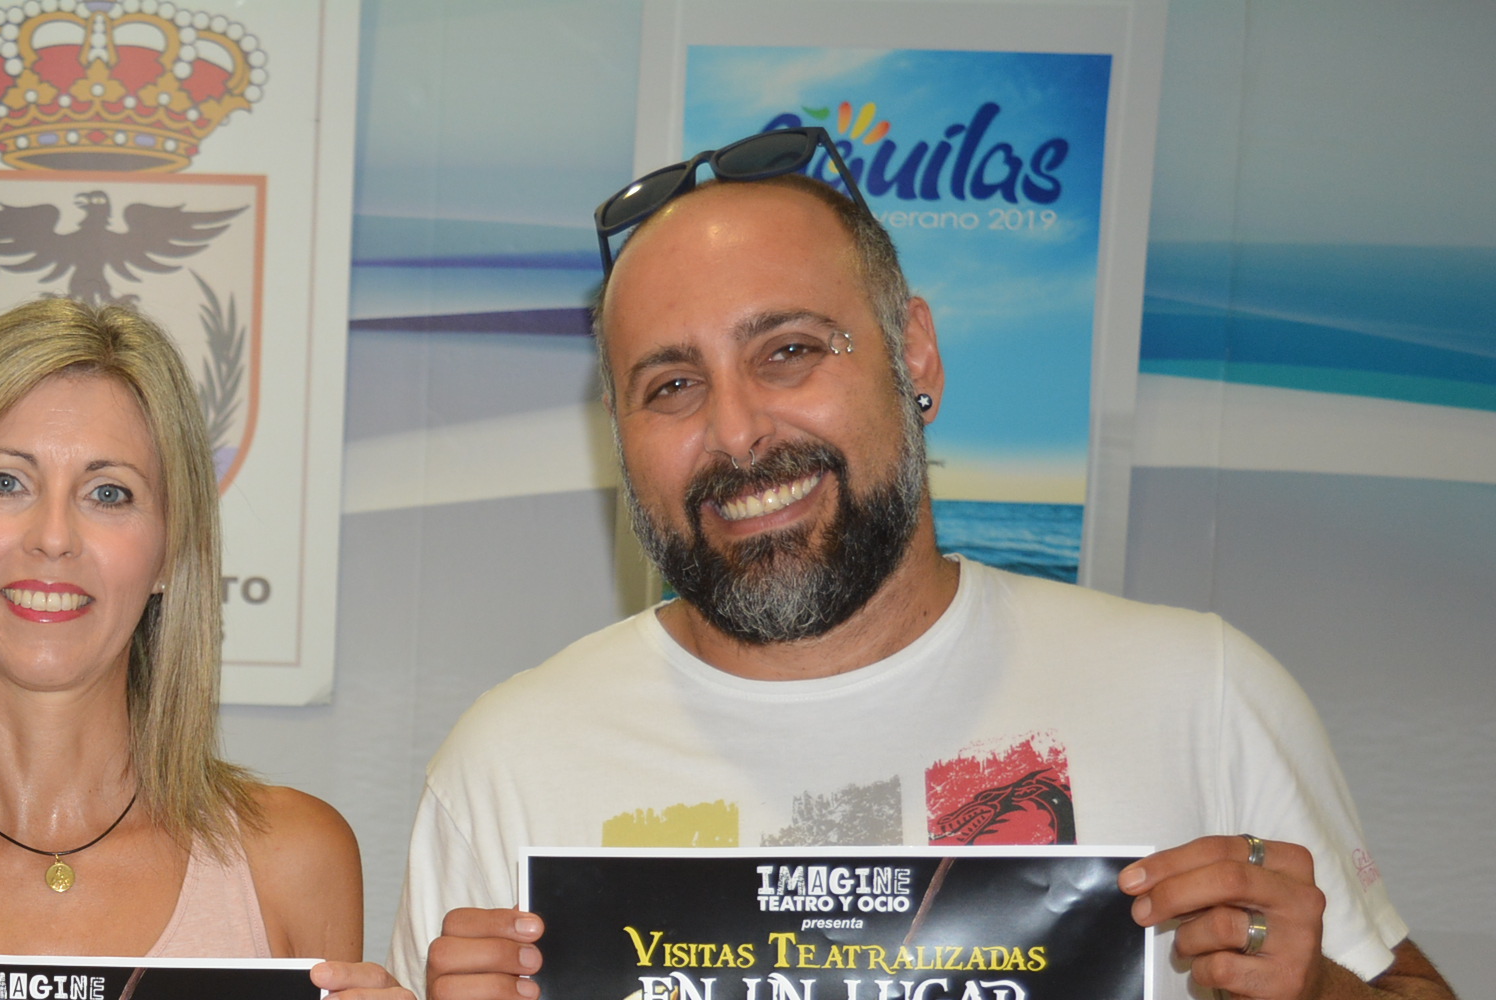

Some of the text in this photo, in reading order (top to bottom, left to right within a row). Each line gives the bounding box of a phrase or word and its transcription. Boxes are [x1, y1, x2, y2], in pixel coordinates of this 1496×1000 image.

[761, 101, 1069, 204] guilas
[987, 207, 1059, 231] 2019
[756, 865, 911, 896] IMAGINE
[757, 896, 910, 912] TEATRO Y OCIO
[801, 917, 864, 931] presenta
[623, 926, 1046, 975] VISITAS TEATRALIZADAS
